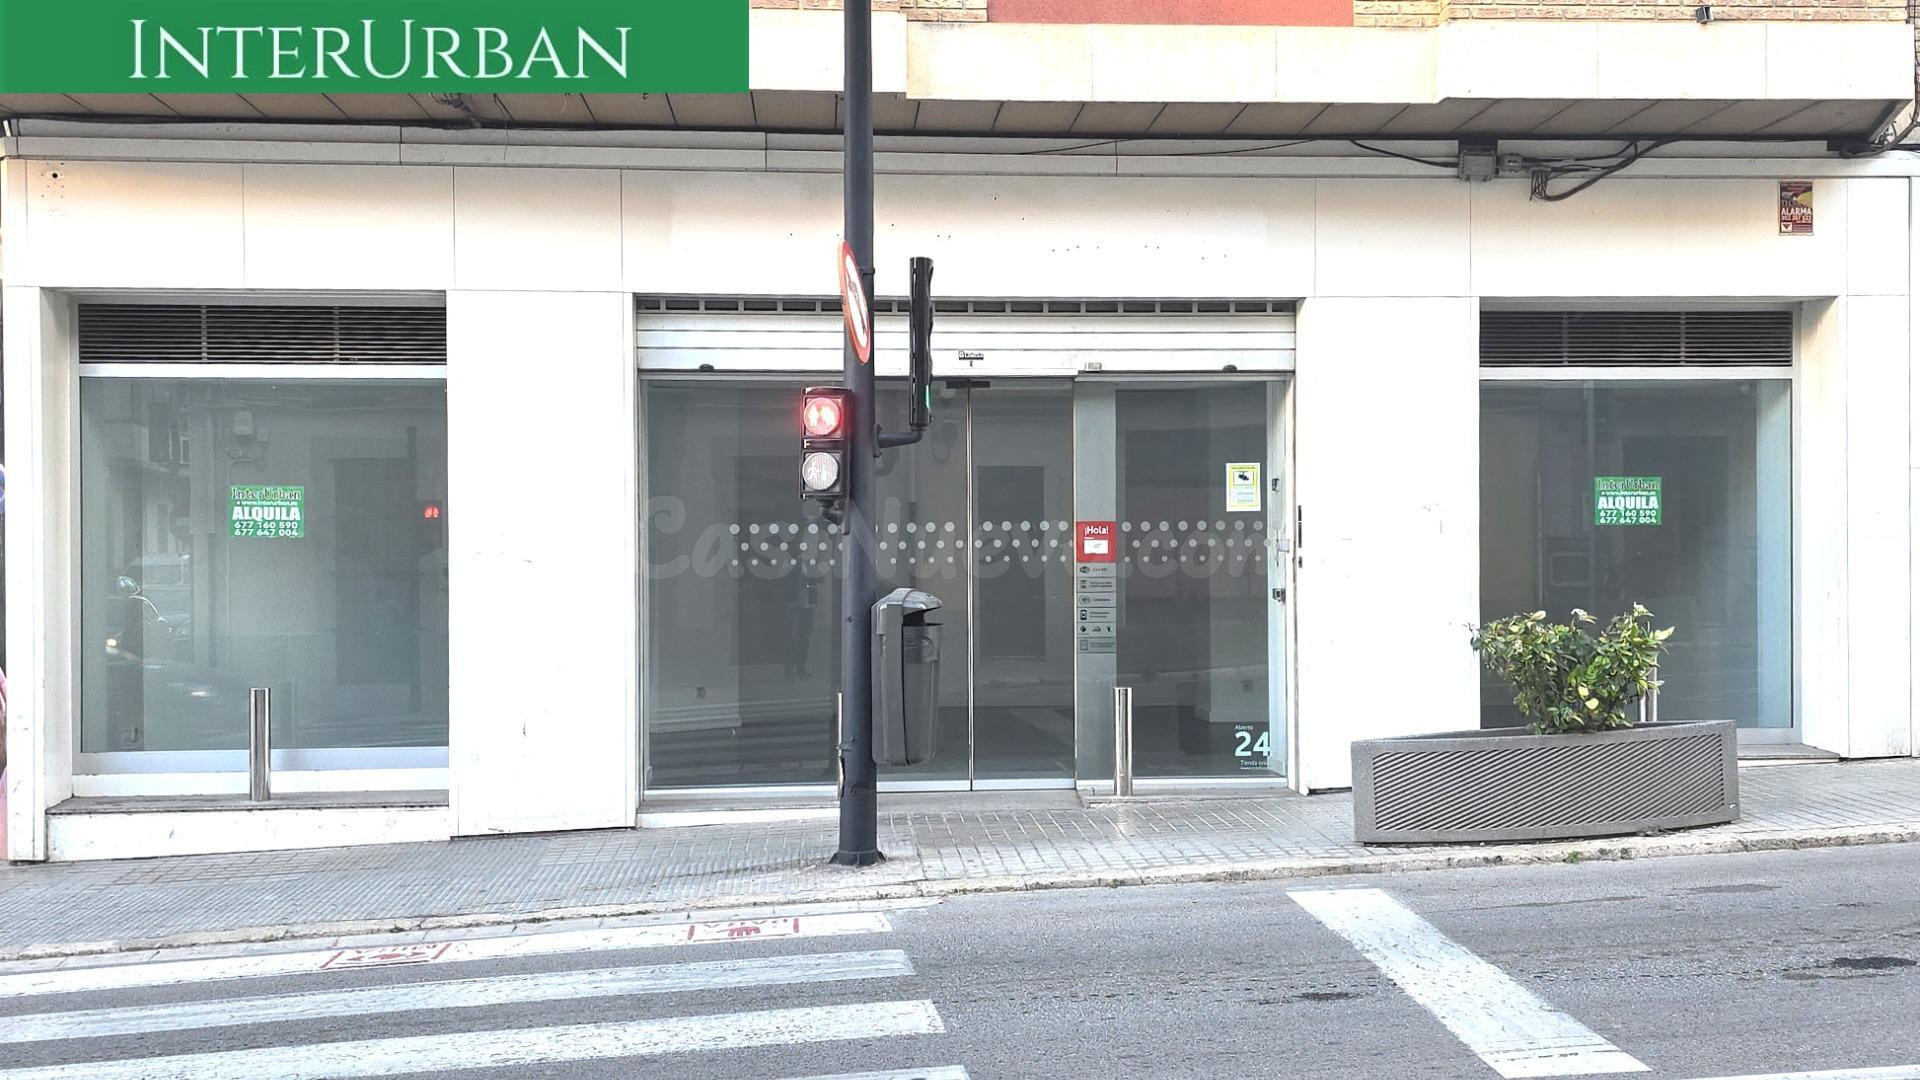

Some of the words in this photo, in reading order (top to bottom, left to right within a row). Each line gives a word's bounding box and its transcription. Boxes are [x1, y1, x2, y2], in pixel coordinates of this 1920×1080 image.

[1781, 207, 1812, 216] ALARMA
[1595, 478, 1660, 491] InterUrban
[232, 487, 302, 500] InterUrban
[1598, 495, 1659, 511] ALQUILA
[232, 506, 302, 521] ALQUILA
[234, 521, 254, 529] 677
[256, 521, 276, 529] 160
[279, 521, 299, 529] 590
[1084, 525, 1109, 536] ¡Hola!
[1234, 731, 1271, 757] 24
